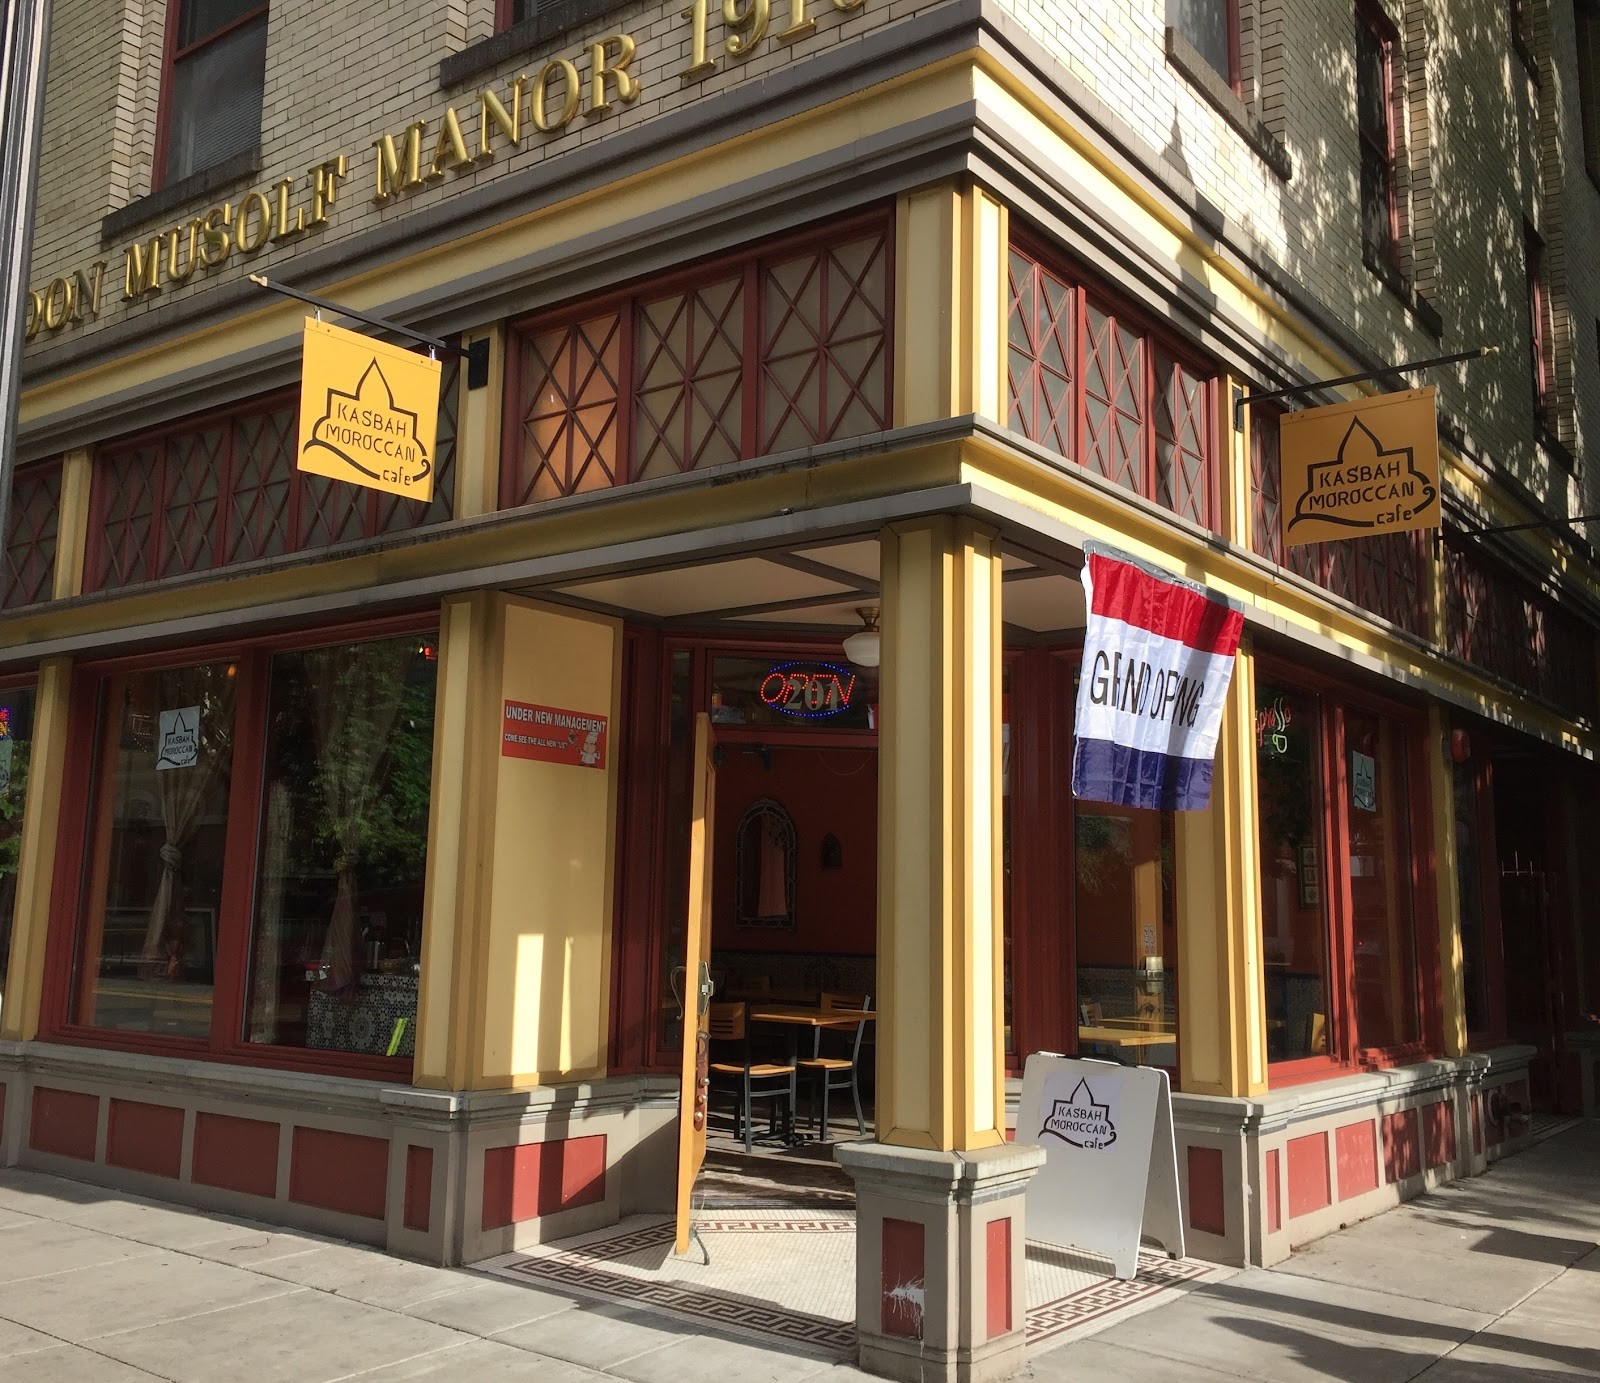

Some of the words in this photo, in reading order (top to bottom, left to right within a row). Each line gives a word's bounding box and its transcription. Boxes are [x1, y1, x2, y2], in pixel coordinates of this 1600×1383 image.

[122, 154, 347, 301] MUSOLF
[371, 33, 642, 202] MANOR
[679, 0, 867, 79] 191
[337, 402, 408, 438] KASBAH
[325, 423, 416, 463] MOROCCAN
[382, 466, 411, 486] cafe
[1319, 460, 1401, 488] KASBAH
[1308, 480, 1415, 511] MOROCCAN
[1376, 504, 1413, 525] cafe
[760, 672, 857, 705] OPEN
[505, 705, 533, 722] UNDER
[535, 710, 554, 725] NEW
[554, 713, 607, 733] MANAGEMENT
[504, 733, 518, 743] COME
[518, 735, 528, 744] SEE
[528, 737, 537, 745] THE
[537, 738, 546, 747] ALL
[1050, 1118, 1108, 1136] MOROCCAN
[1058, 1106, 1103, 1121] KASBAH
[1084, 1137, 1105, 1150] cafe
